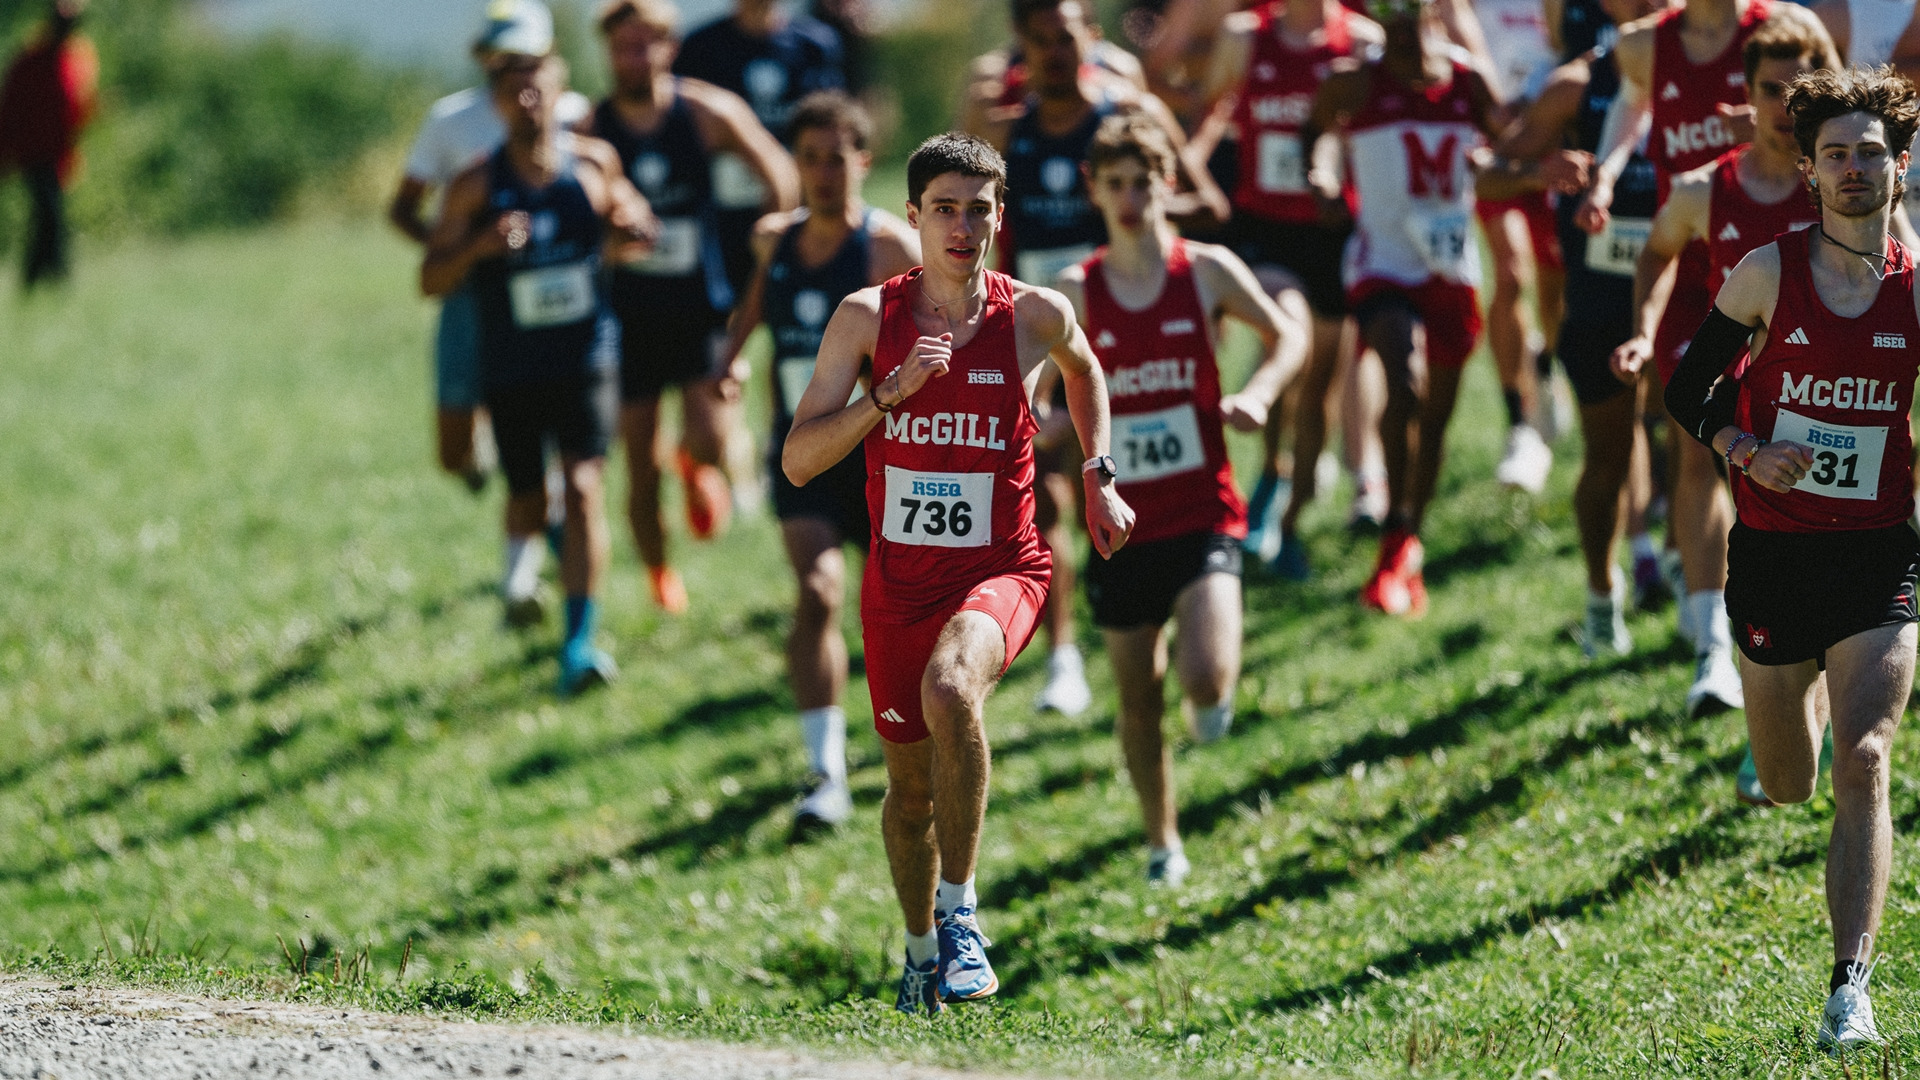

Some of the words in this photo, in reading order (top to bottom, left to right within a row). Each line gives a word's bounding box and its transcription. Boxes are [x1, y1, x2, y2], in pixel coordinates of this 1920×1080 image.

[1664, 115, 1734, 157] McG
[1403, 131, 1457, 198] M
[1873, 336, 1906, 348] RSEQ
[967, 372, 1005, 384] RSEQ
[1104, 357, 1196, 399] McGILL
[1779, 371, 1898, 411] McGILL
[884, 412, 1005, 451] McGILL
[1807, 428, 1856, 449] RSEQ
[1124, 433, 1182, 470] 740
[1811, 447, 1859, 488] 31
[912, 481, 962, 497] RSEQ
[900, 498, 972, 537] 736
